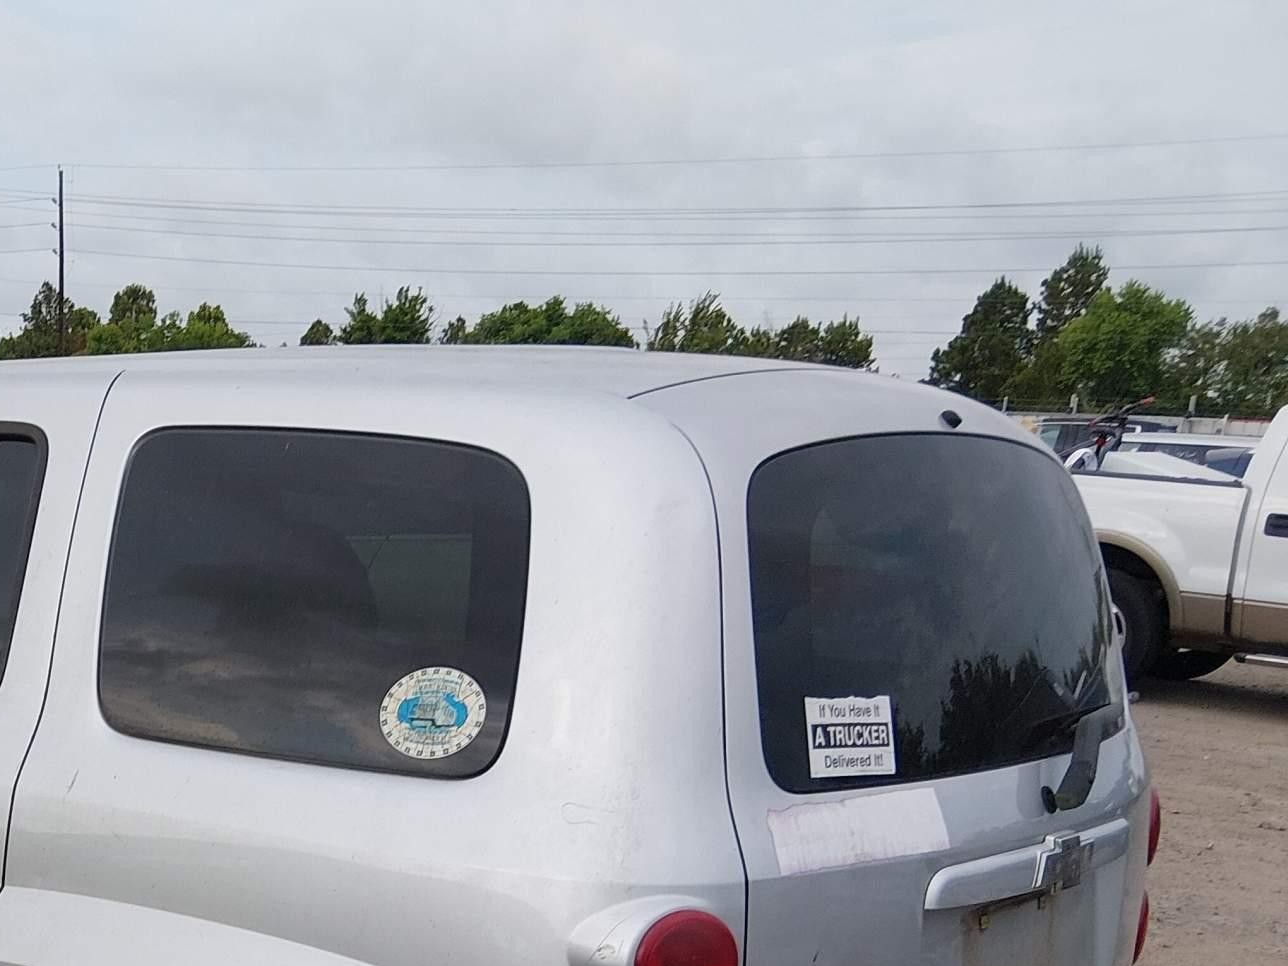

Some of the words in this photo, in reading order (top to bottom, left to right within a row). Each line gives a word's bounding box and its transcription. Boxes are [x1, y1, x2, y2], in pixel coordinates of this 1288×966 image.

[819, 704, 826, 718] If
[828, 704, 846, 718] You
[848, 703, 872, 718] Have
[873, 703, 880, 717] It
[815, 726, 826, 747] A
[827, 725, 888, 746] TRUCKER
[824, 753, 871, 769] Delivered
[874, 753, 883, 767] It!
